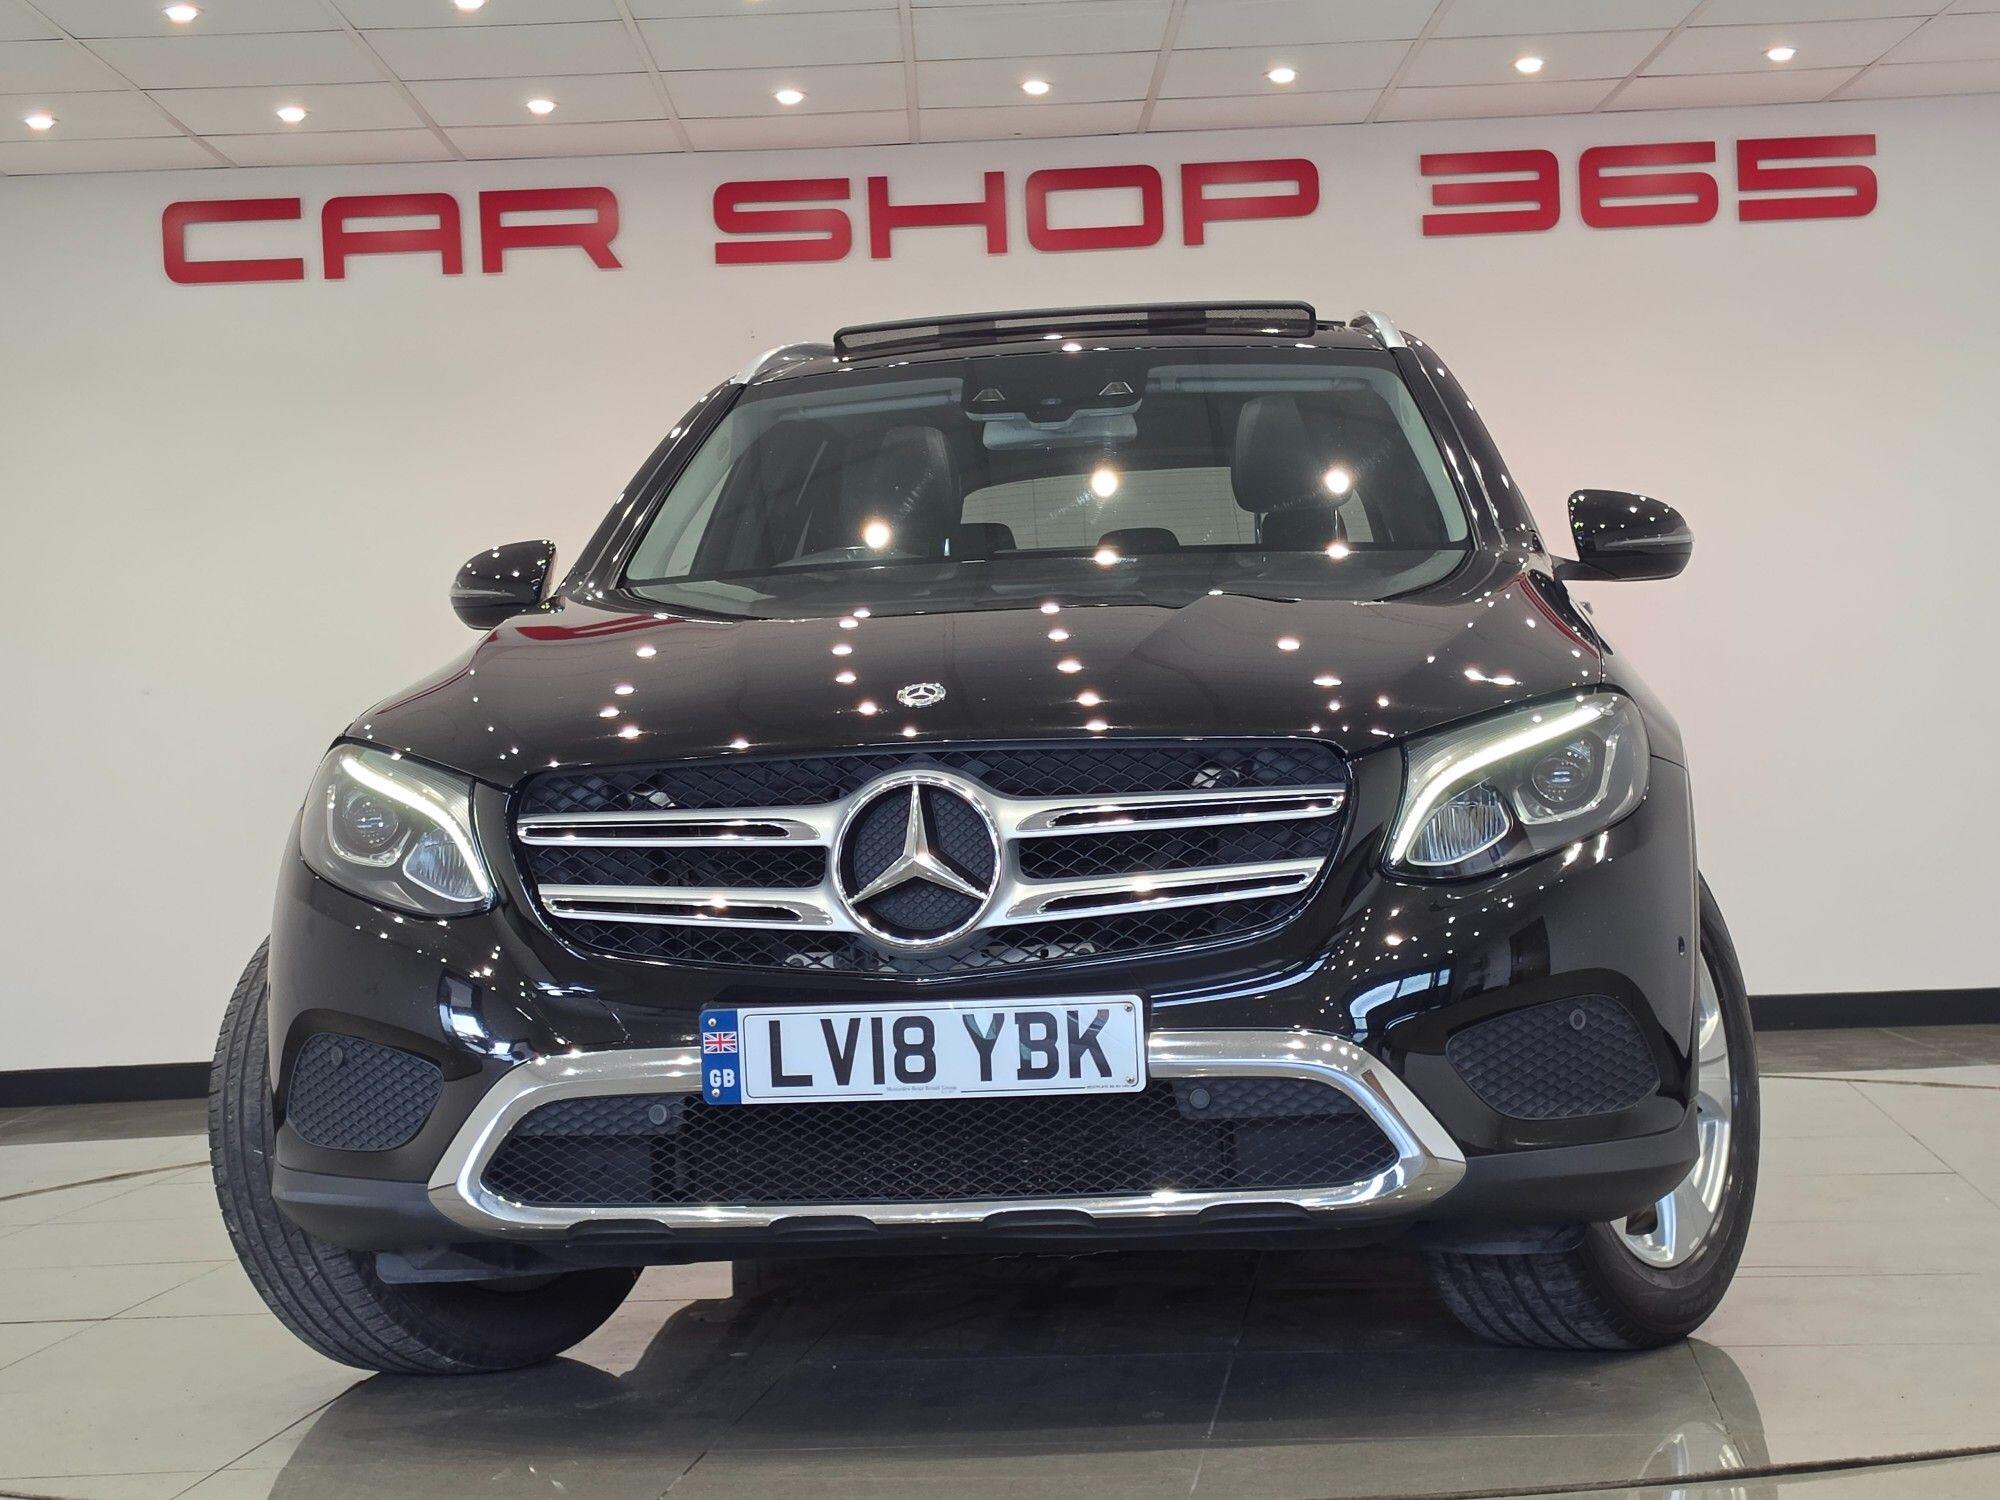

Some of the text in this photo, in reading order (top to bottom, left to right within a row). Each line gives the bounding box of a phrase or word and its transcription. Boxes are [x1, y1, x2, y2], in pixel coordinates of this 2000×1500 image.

[162, 134, 1878, 284] CAR SHOP 365
[709, 1068, 736, 1088] GB
[768, 1010, 1112, 1088] LV18 YBK
